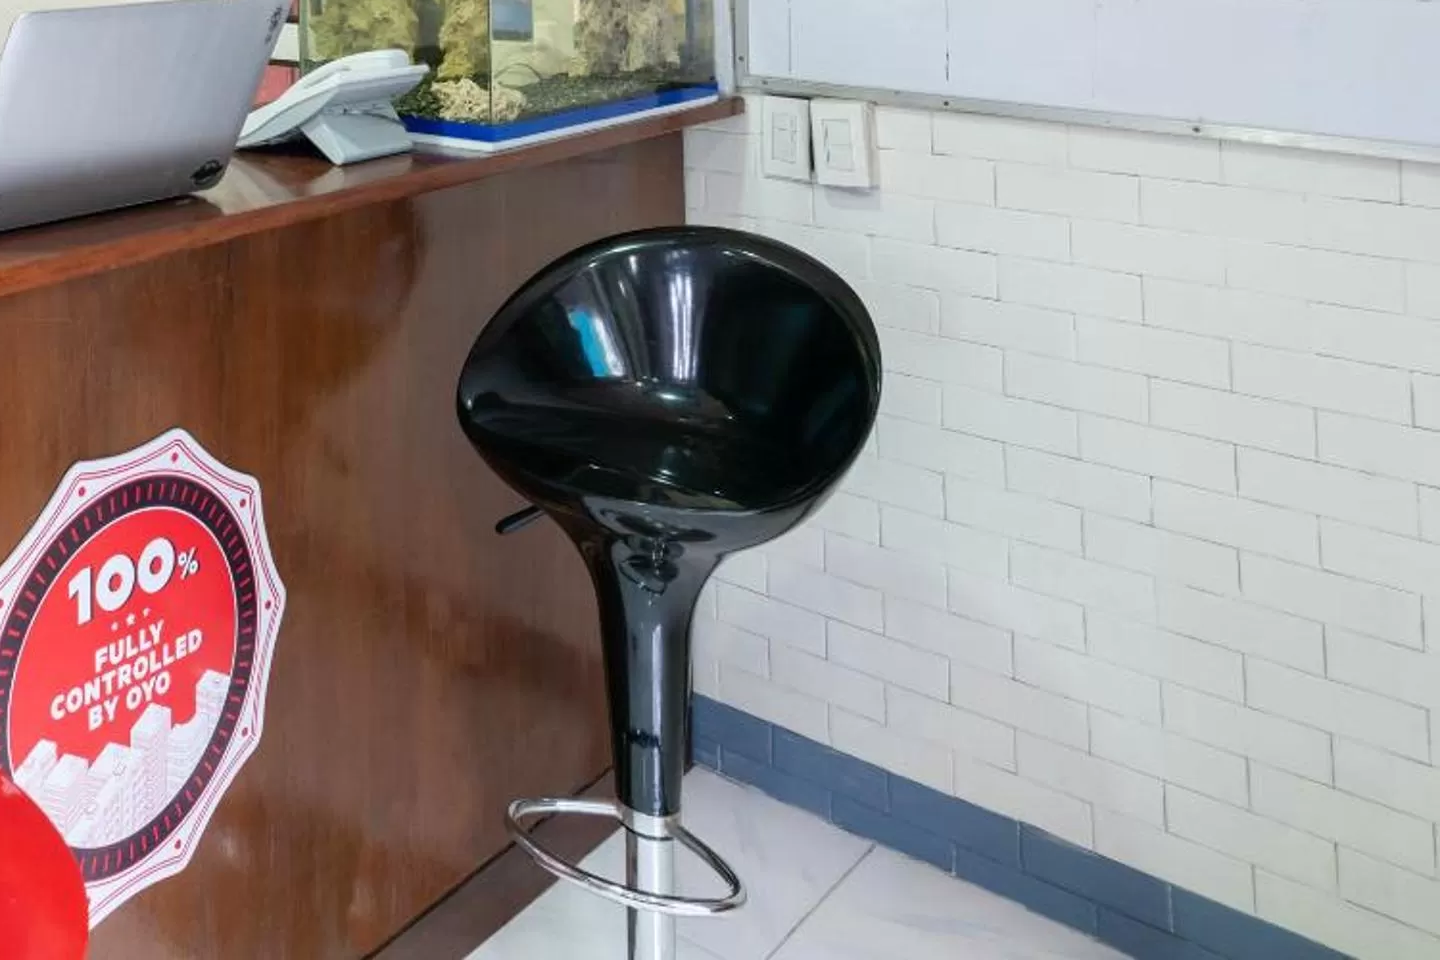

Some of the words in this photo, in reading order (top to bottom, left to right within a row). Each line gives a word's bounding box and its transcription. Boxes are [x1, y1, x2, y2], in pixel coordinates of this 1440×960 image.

[68, 537, 200, 625] 100%
[50, 628, 203, 720] CONTROLLED
[95, 619, 165, 673] FULLY
[88, 695, 120, 731] BY
[126, 671, 171, 710] OYO
